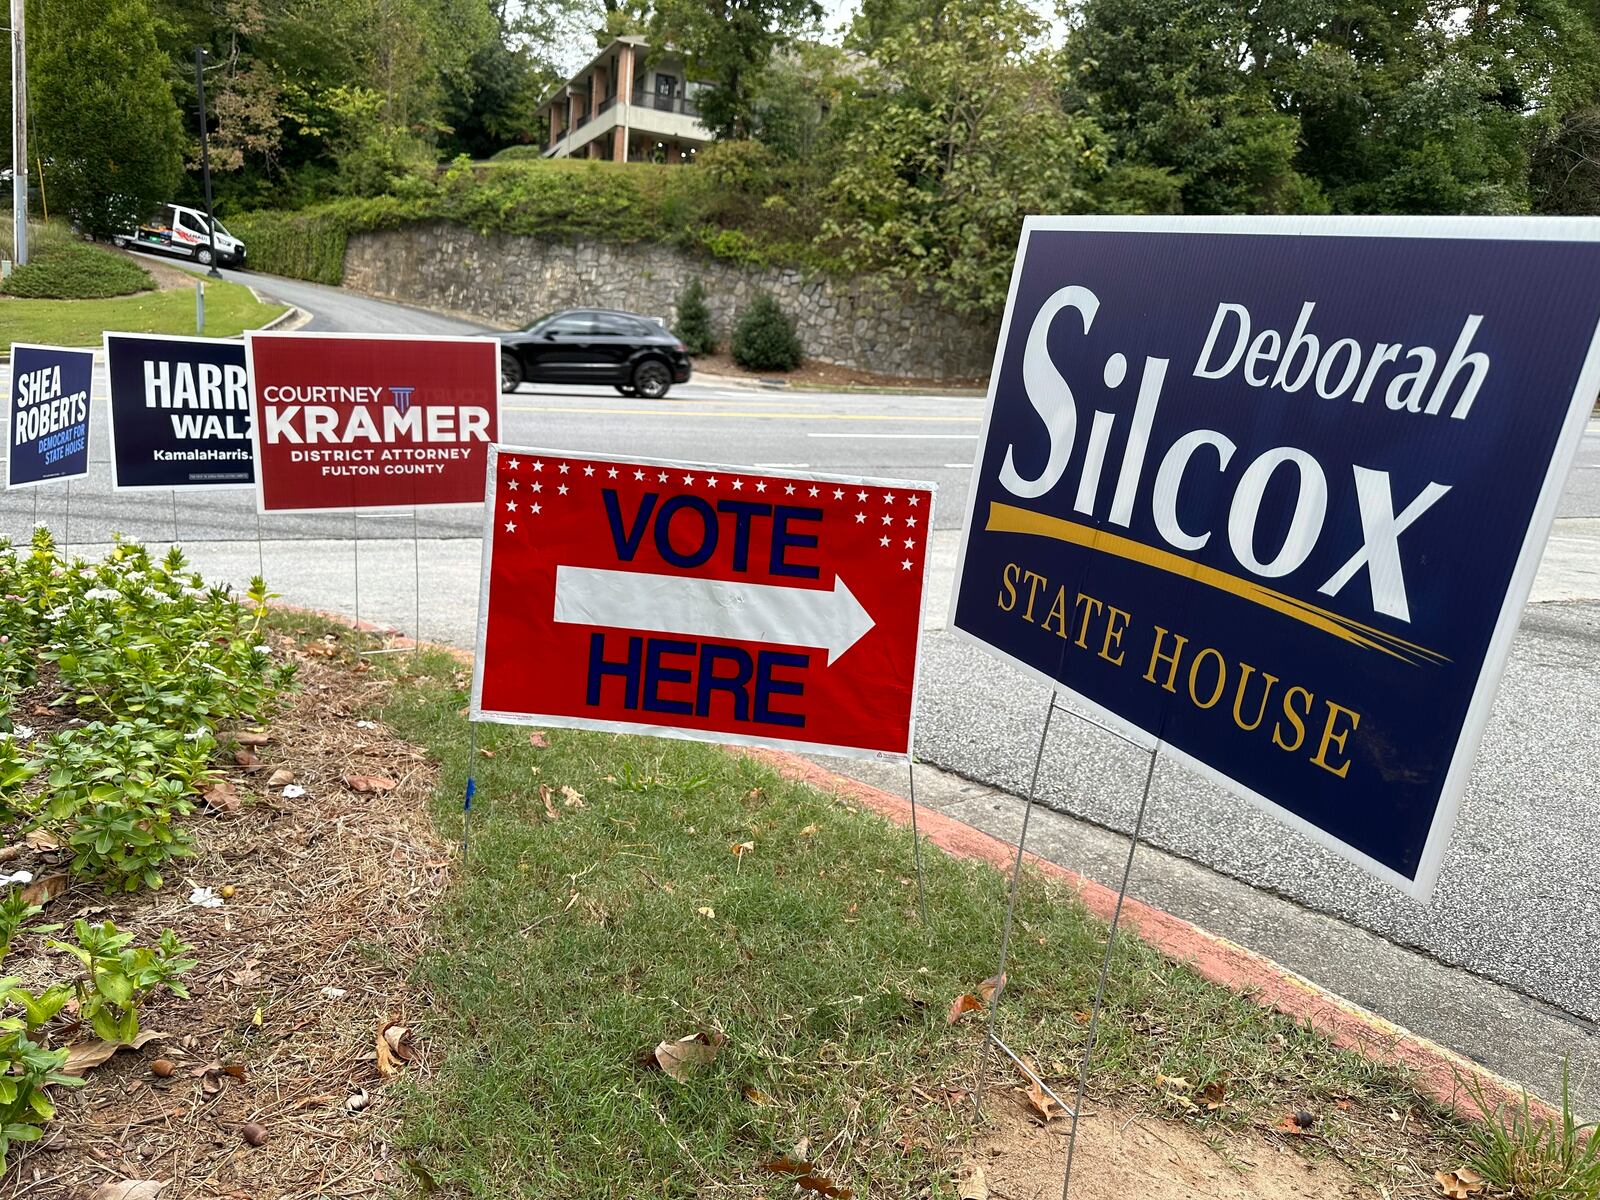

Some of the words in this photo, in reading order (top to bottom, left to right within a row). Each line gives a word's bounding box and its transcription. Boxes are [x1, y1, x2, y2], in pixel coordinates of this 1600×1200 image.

[1192, 301, 1490, 420] Deborah
[17, 365, 61, 408] SHEA
[143, 360, 249, 410] HARR
[263, 385, 383, 403] COURTNEY
[15, 390, 87, 446] ROBERTS
[38, 428, 73, 453] DEMOCRAT
[73, 423, 85, 438] FOR
[264, 404, 492, 444] KRAMER
[45, 446, 64, 465] STATE
[65, 439, 85, 457] HOUSE
[153, 448, 253, 461] KamalaHarris.
[291, 449, 375, 462] DISTRICT
[381, 448, 471, 460] ATTORNEY
[321, 465, 380, 476] FULTON
[384, 464, 445, 475] COUNTY
[998, 284, 1453, 624] Silcox
[602, 488, 824, 580] VOTE
[586, 633, 809, 728] HERE
[997, 562, 1132, 667] STATE
[1142, 625, 1361, 780] HOUSE
